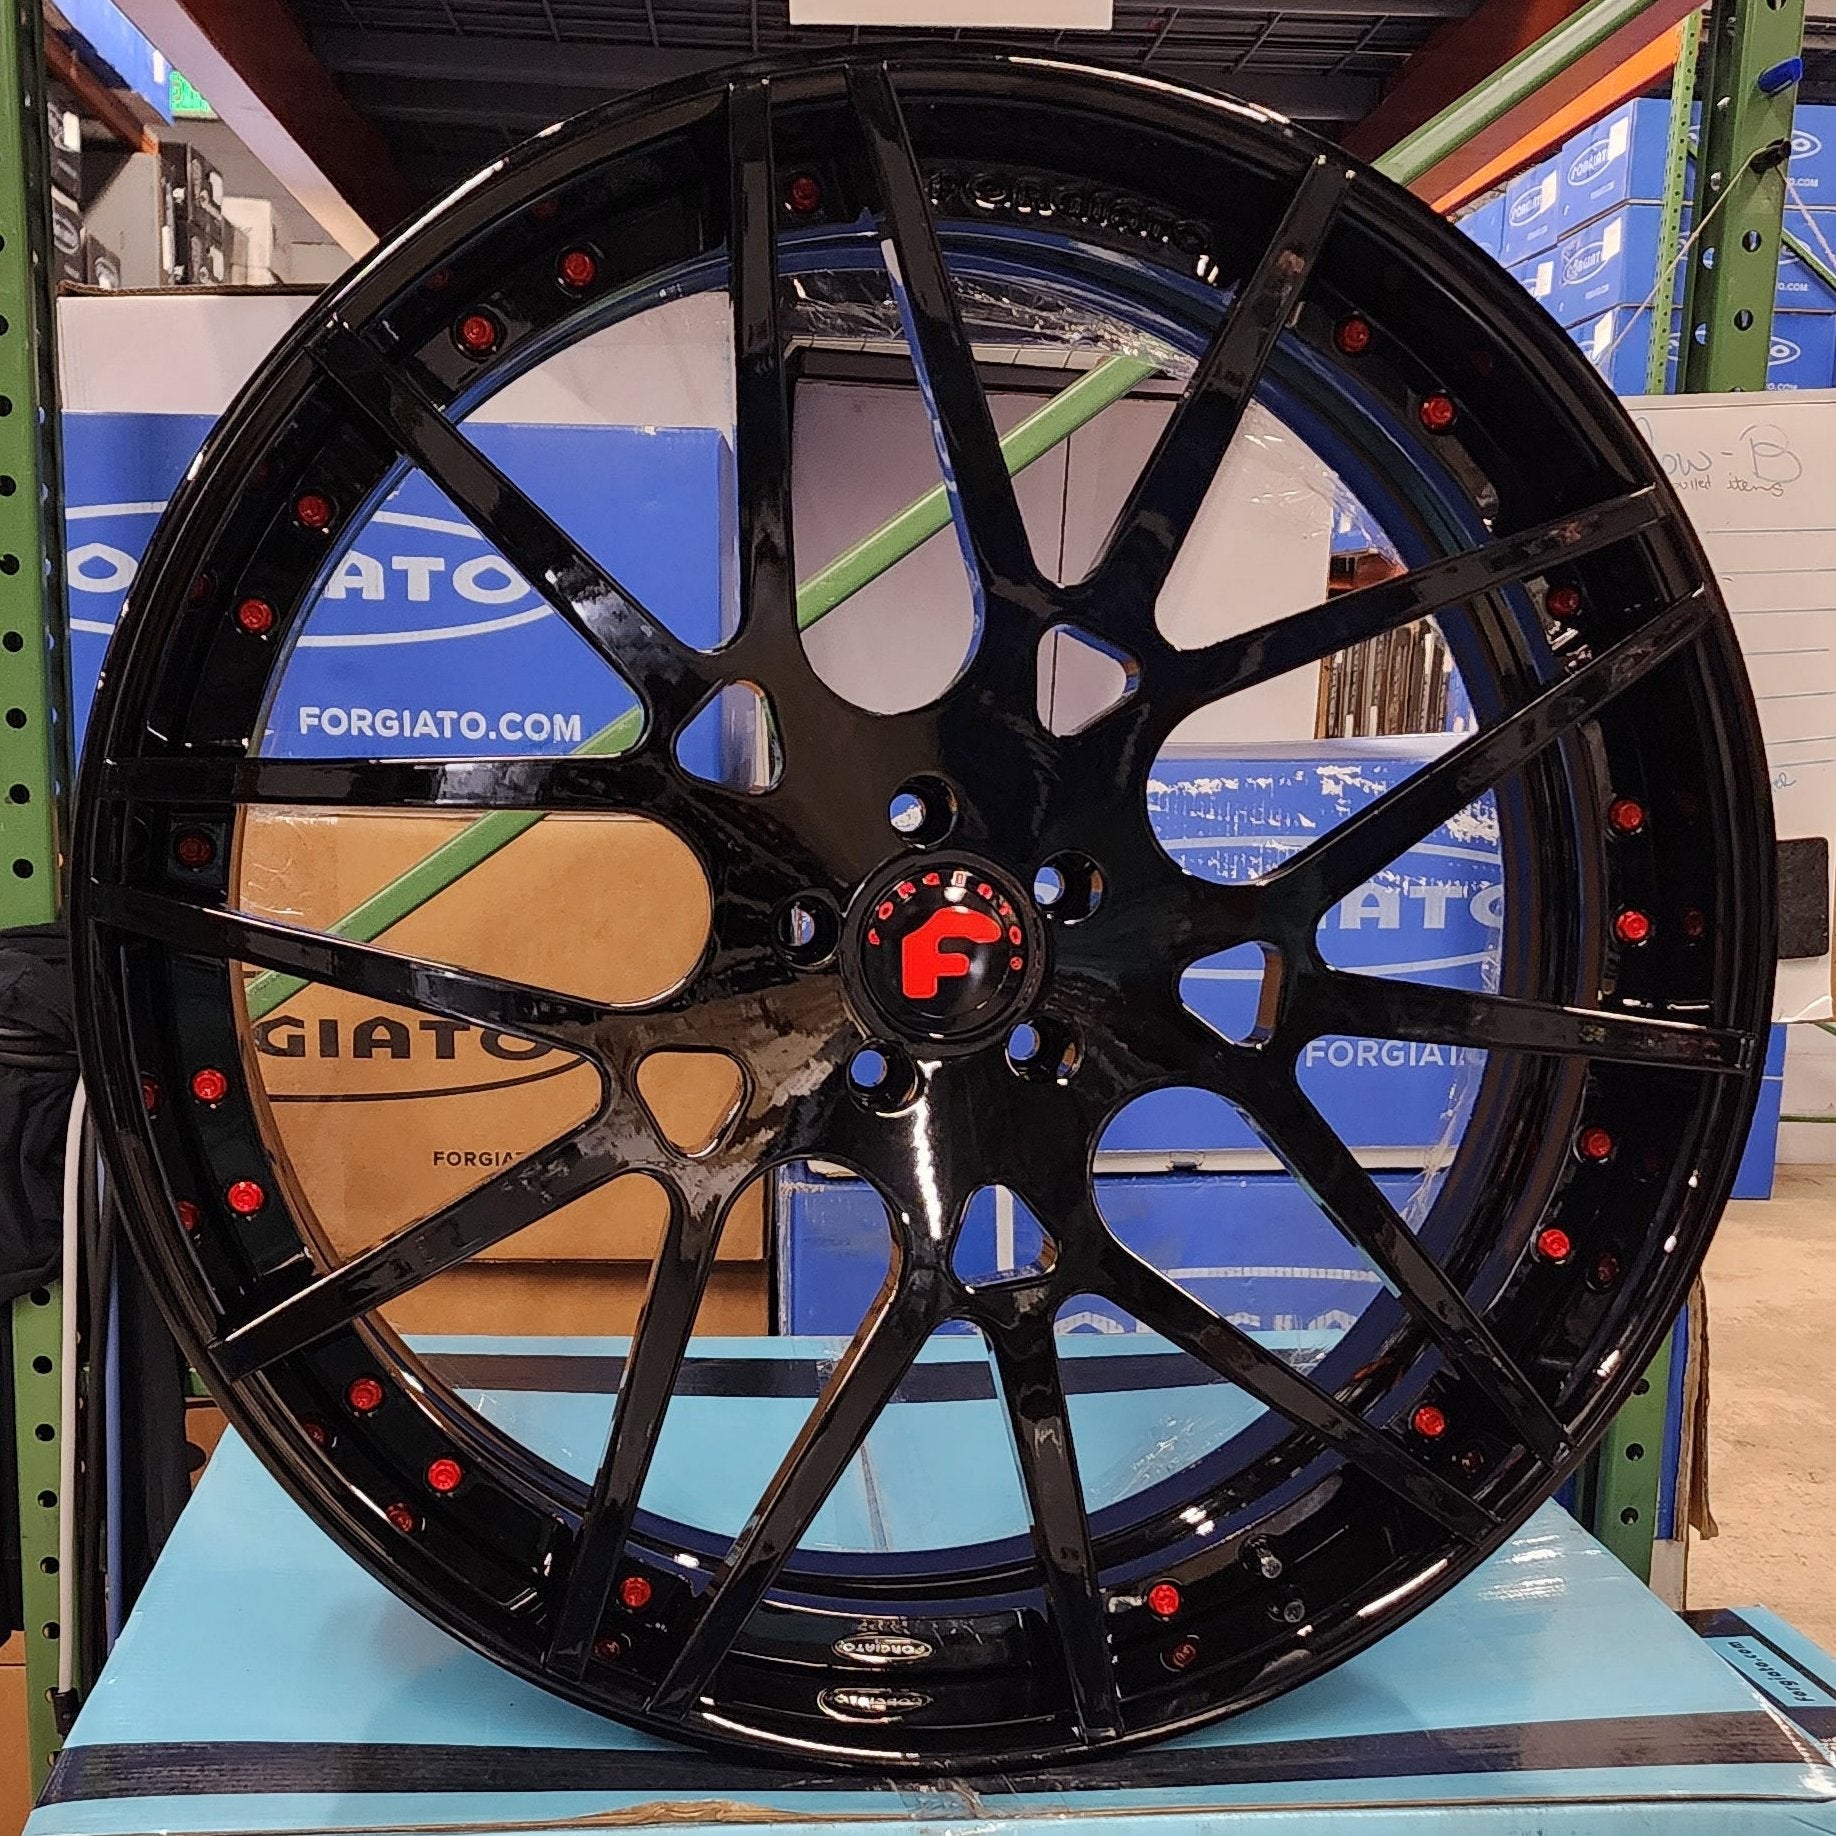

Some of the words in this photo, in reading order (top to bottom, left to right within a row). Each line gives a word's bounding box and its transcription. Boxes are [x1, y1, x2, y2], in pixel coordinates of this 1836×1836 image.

[1727, 473, 1784, 497] items
[299, 706, 581, 742] FORGIATO.COM
[902, 905, 1001, 999] F
[433, 1151, 525, 1167] FORGIA
